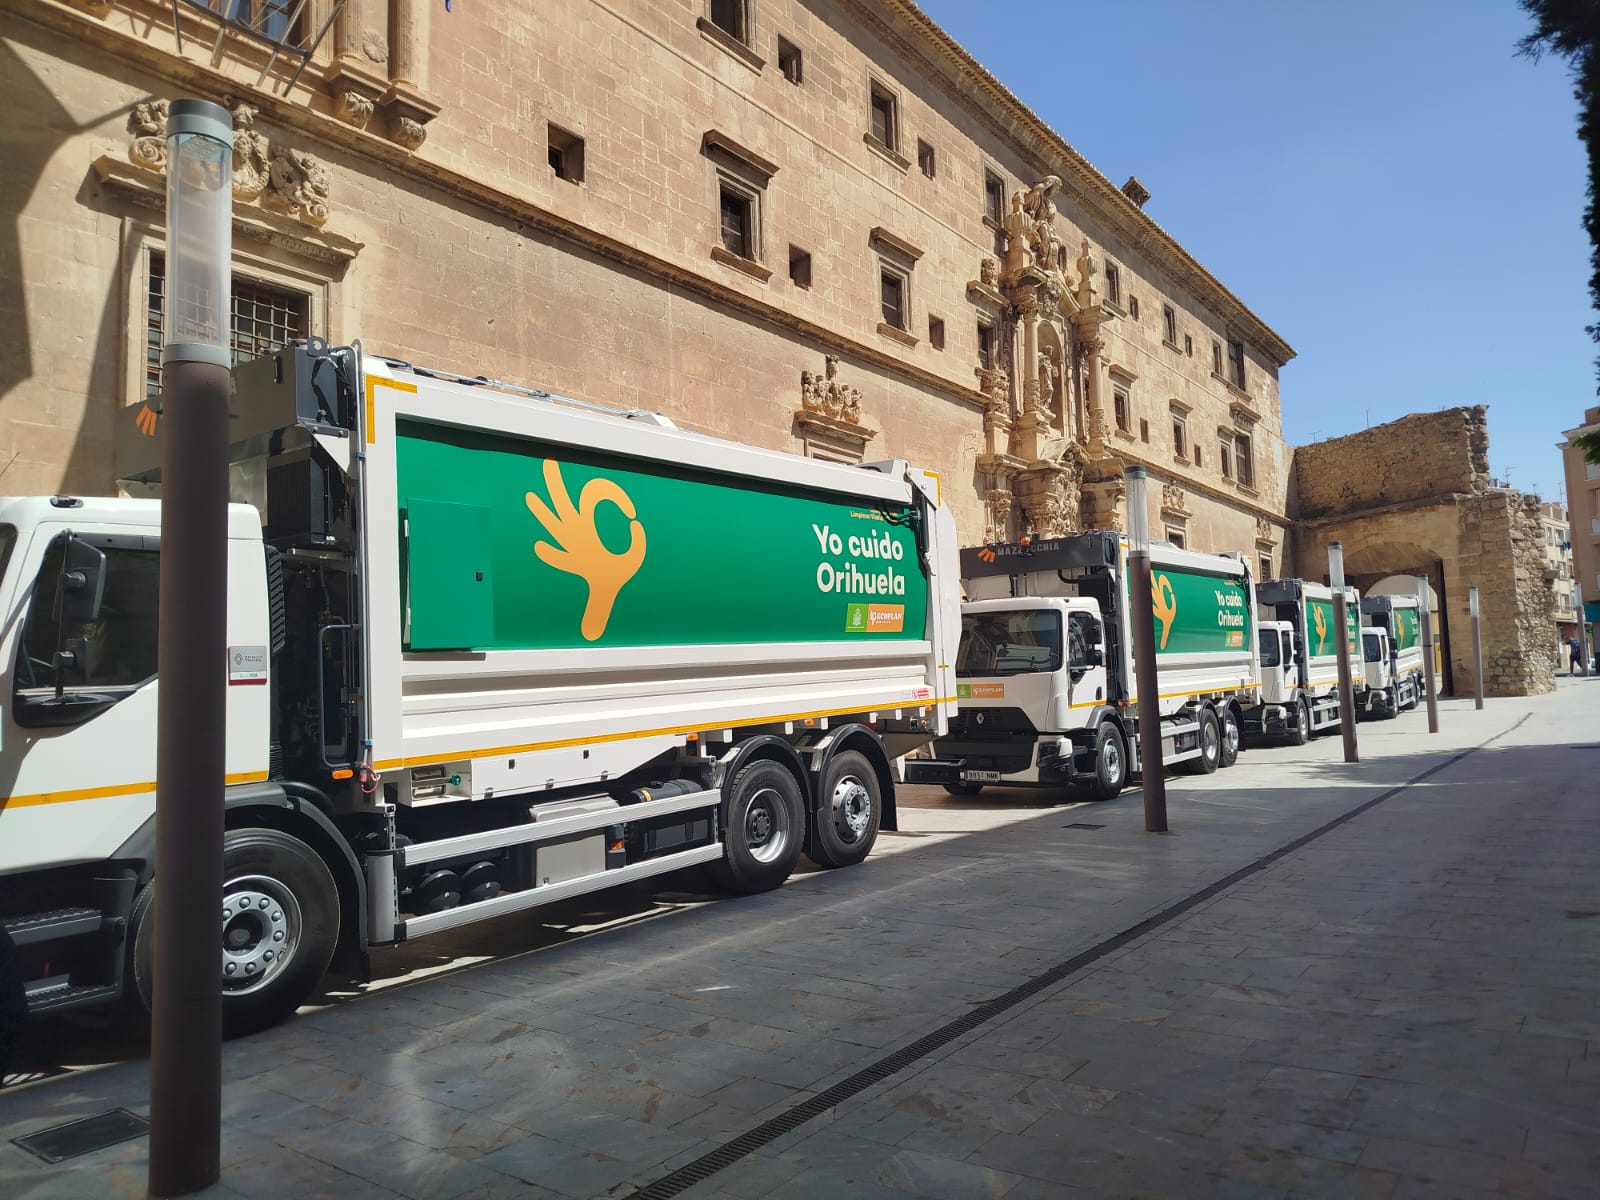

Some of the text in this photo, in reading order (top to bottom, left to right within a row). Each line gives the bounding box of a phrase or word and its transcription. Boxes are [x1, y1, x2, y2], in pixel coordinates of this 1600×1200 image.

[812, 524, 904, 560] Yo cuido
[997, 542, 1060, 556] MAZZCCHIA
[816, 562, 905, 595] Orihuela
[1214, 590, 1243, 607] Yo cuido
[876, 612, 902, 620] ECOPLAN
[1217, 609, 1244, 627] Orihuela
